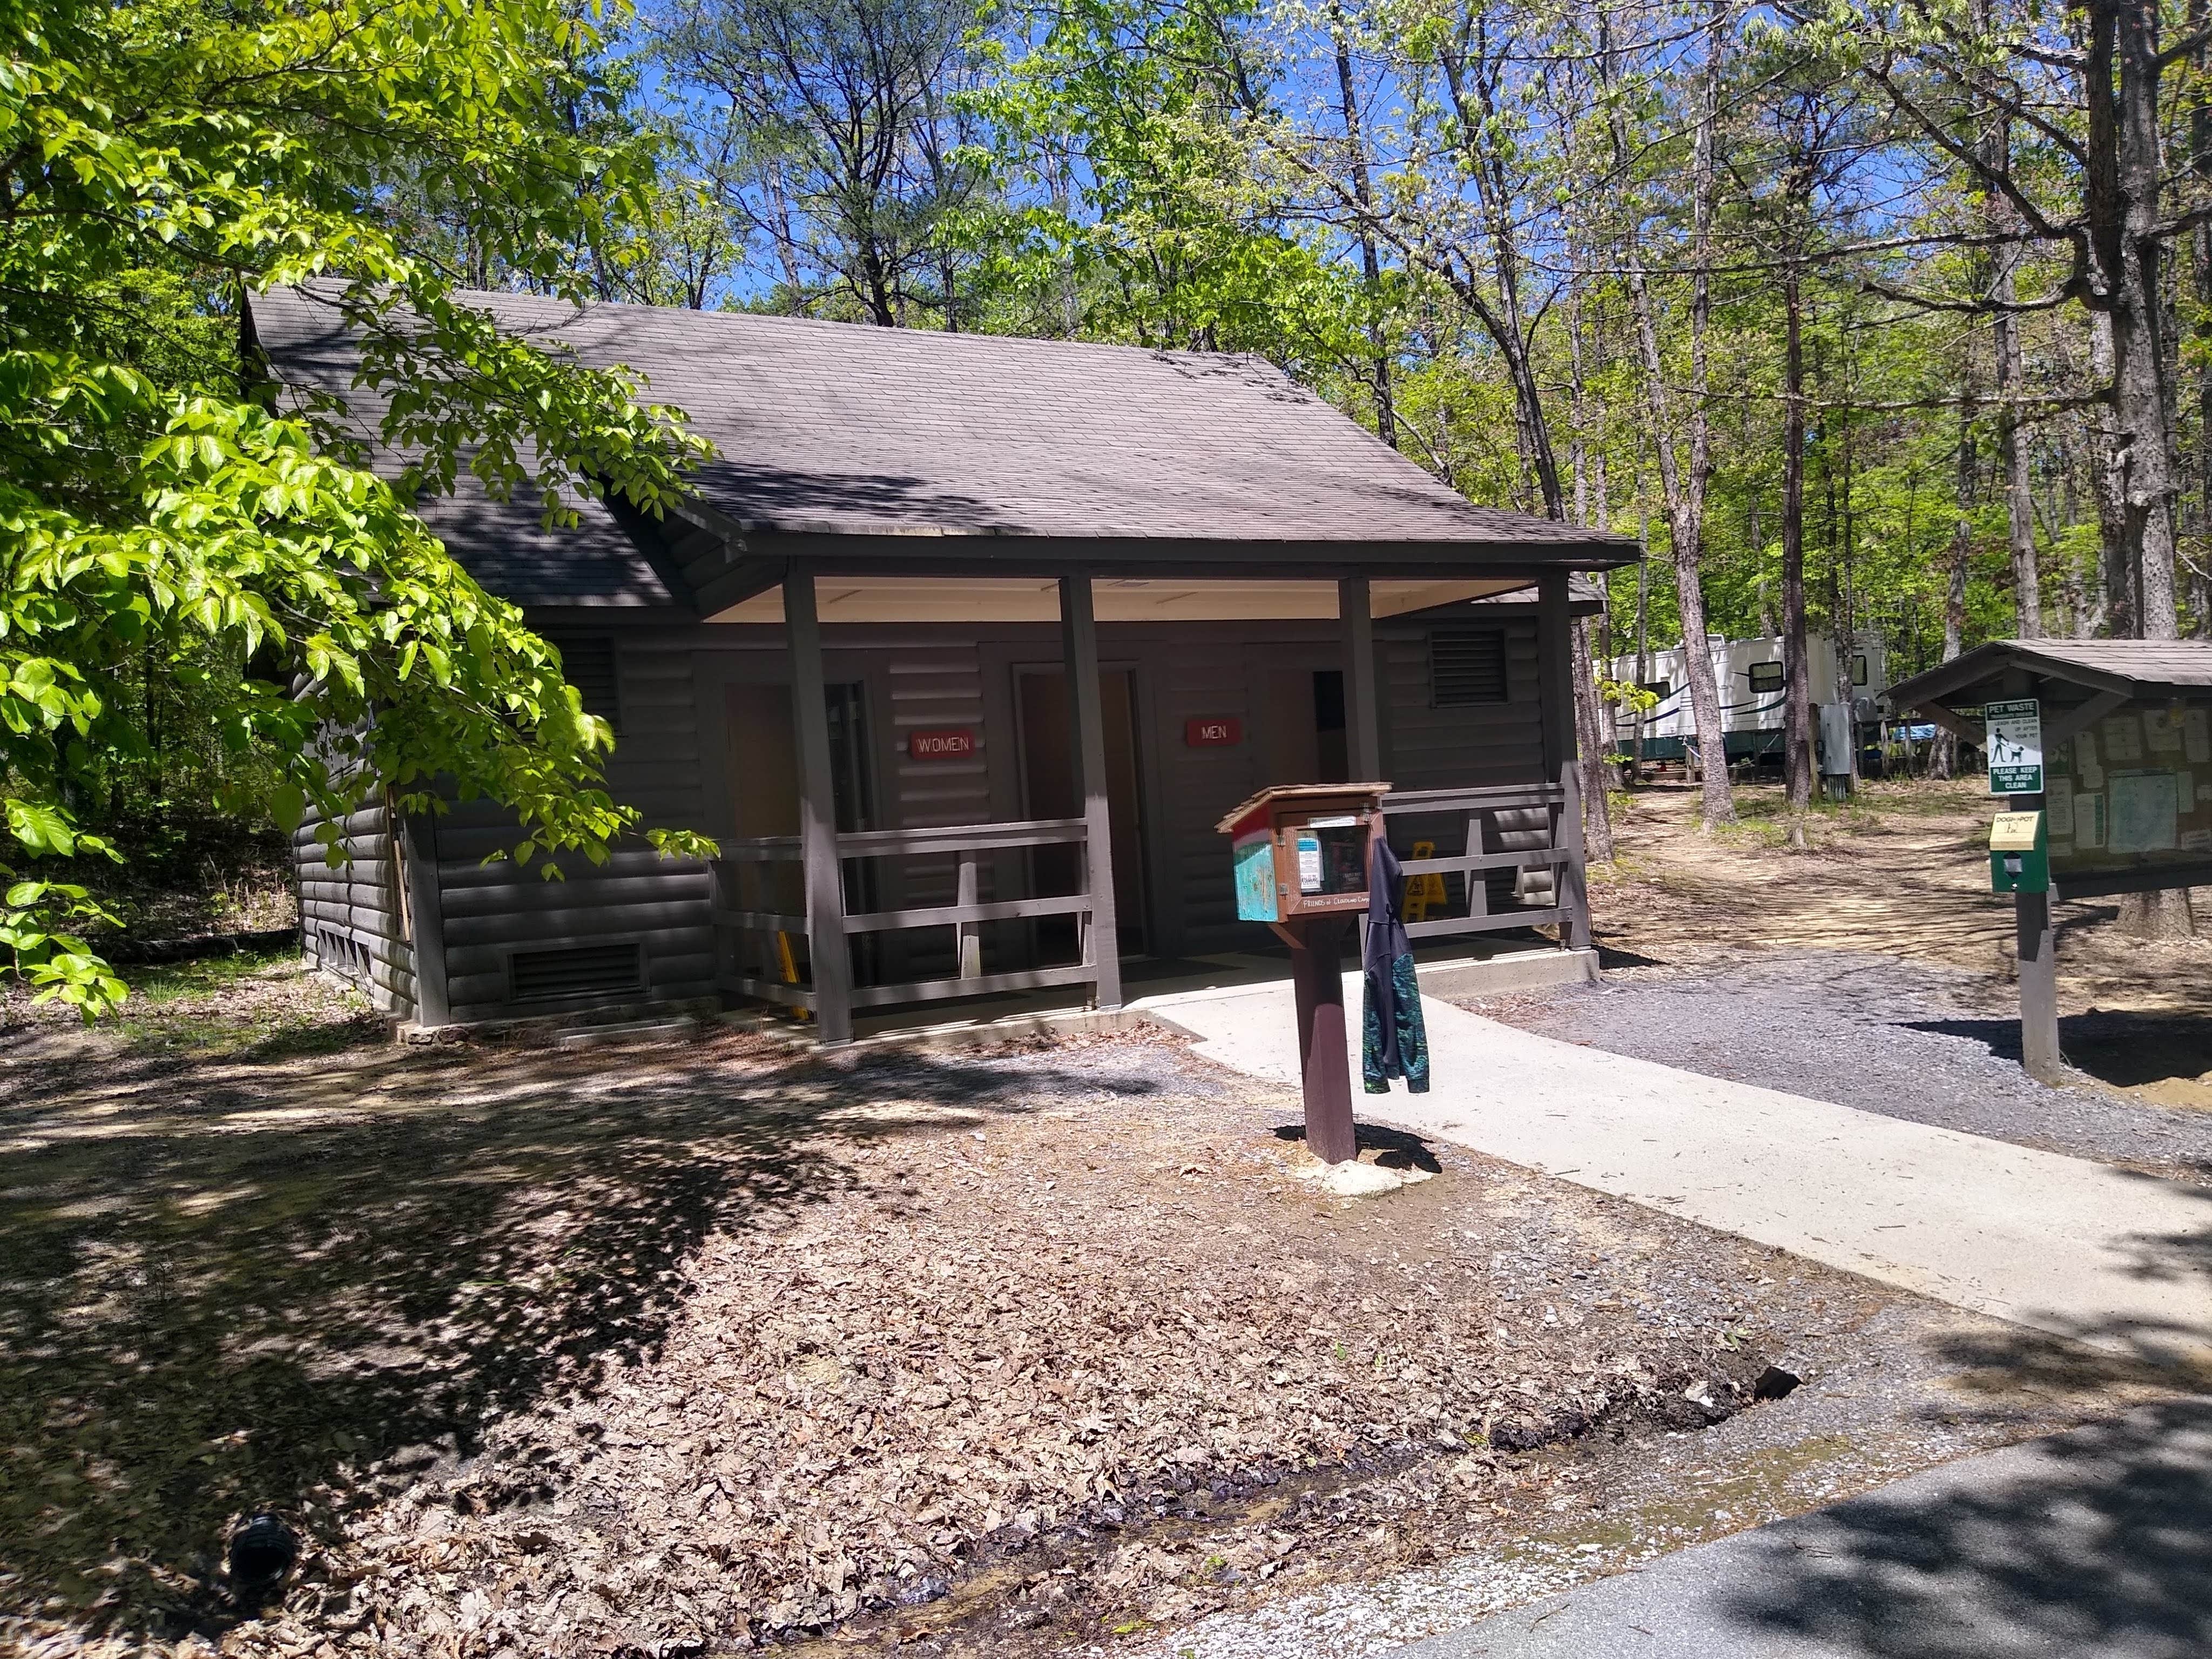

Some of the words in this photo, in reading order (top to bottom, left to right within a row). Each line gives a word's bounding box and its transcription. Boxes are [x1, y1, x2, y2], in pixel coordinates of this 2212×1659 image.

[2007, 703, 2034, 711] WASTE
[1201, 725, 1227, 739] MEN
[916, 737, 969, 752] WOMEN
